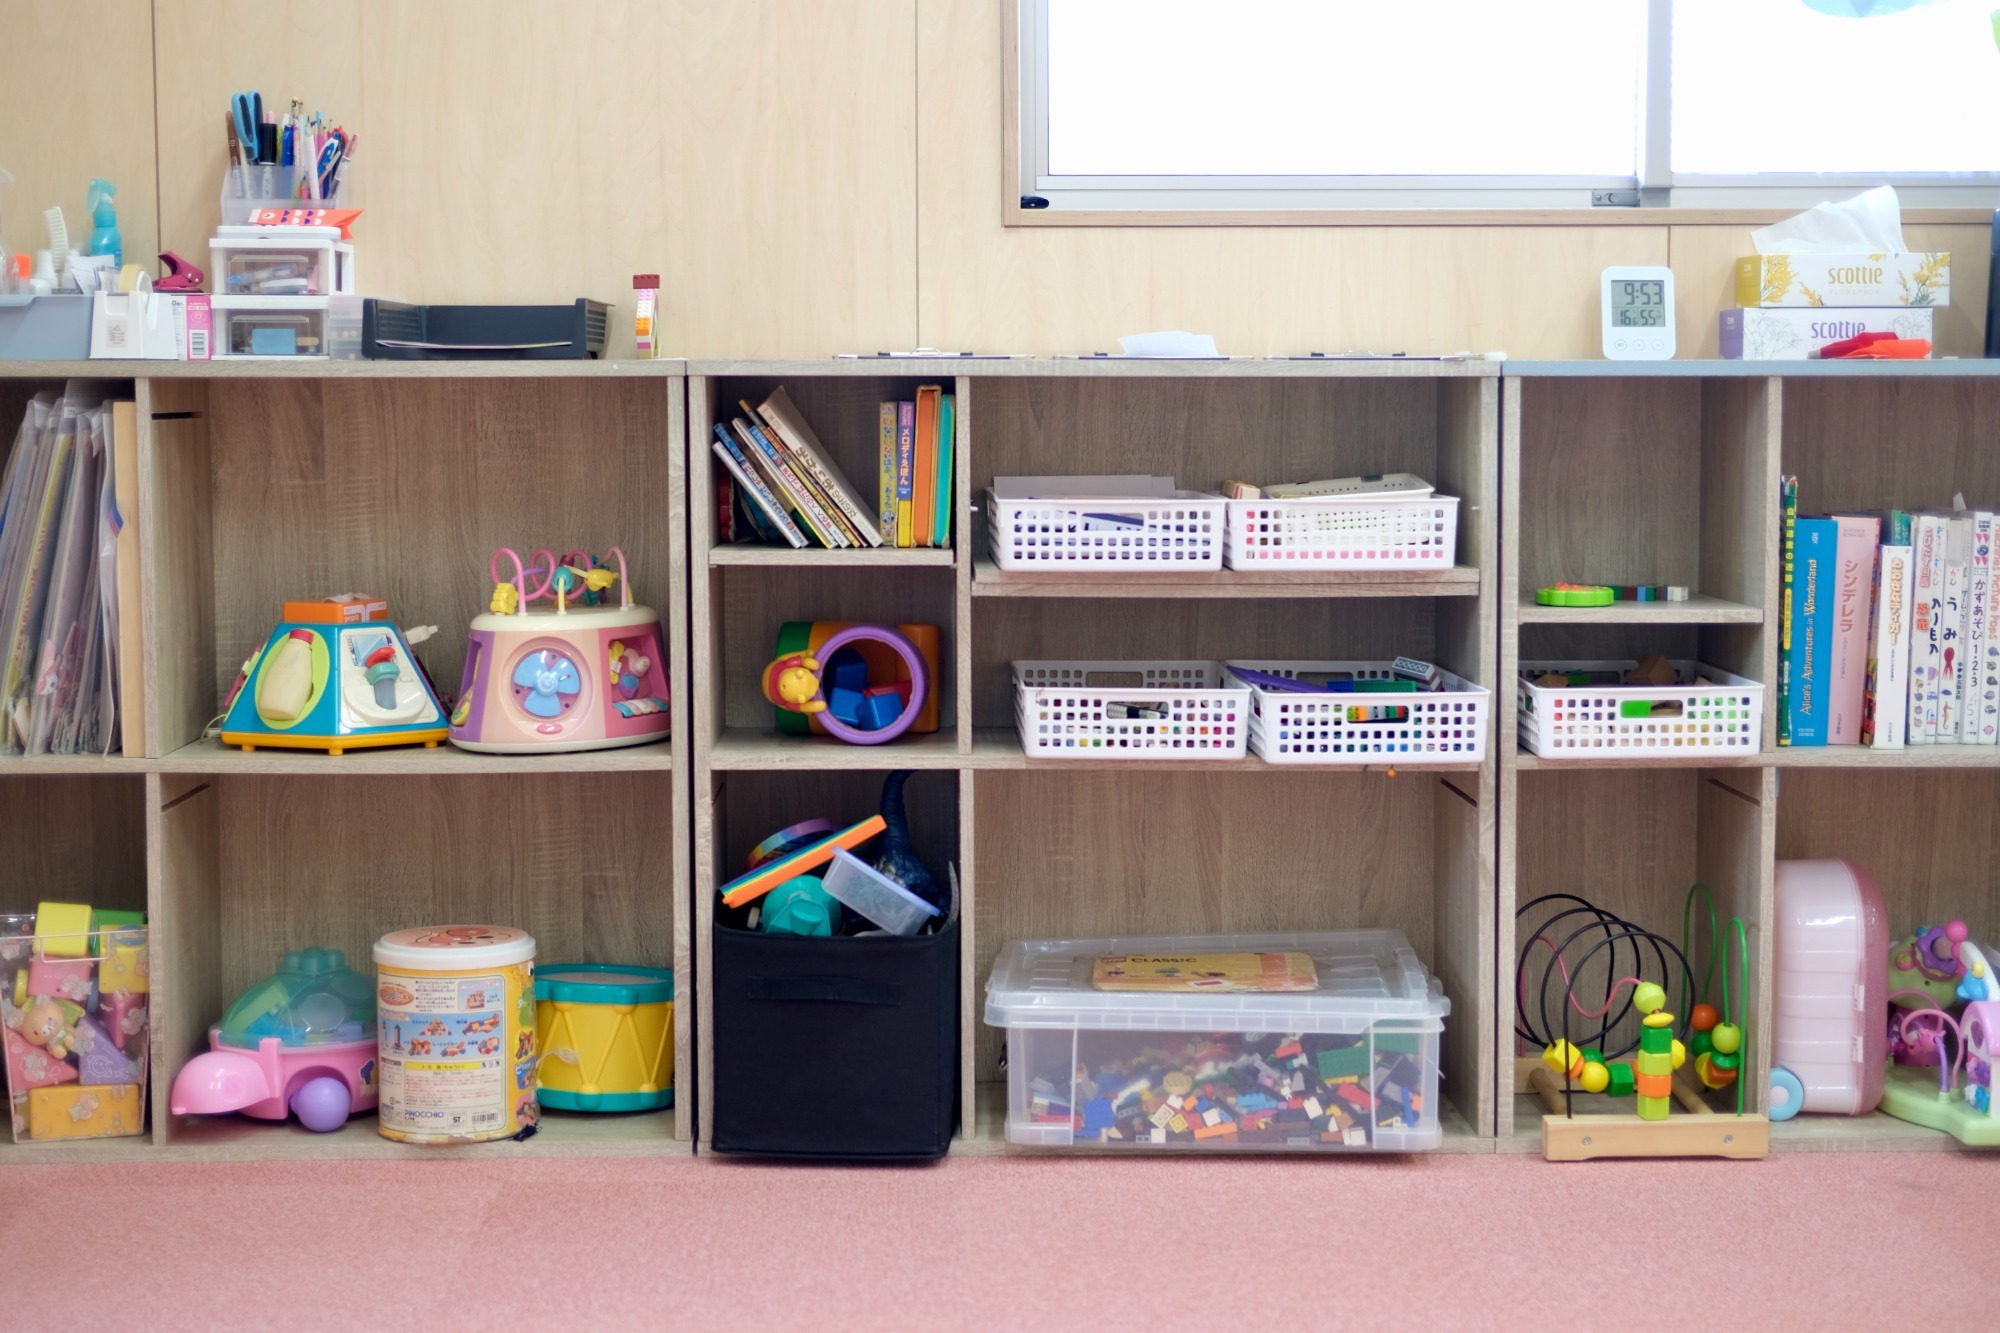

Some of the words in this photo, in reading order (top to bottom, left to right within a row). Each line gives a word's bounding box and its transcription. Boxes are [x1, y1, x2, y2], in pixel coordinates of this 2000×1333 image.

[1828, 266, 1883, 285] scottie
[1624, 282, 1662, 305] 9:53
[1640, 309, 1656, 326] 55
[1811, 320, 1866, 339] scottie
[900, 428, 911, 486] メロディえほん
[1804, 558, 1817, 616] Wonderland
[1840, 560, 1859, 633] シンデレラ
[1916, 603, 1929, 632] 恐竜
[1943, 596, 1957, 641] うみ
[1988, 615, 1999, 642] Pops
[1801, 626, 1814, 681] Adventures
[1800, 683, 1812, 716] Alice's
[404, 1109, 445, 1118] PINOCCHIO
[452, 1116, 462, 1124] ST
